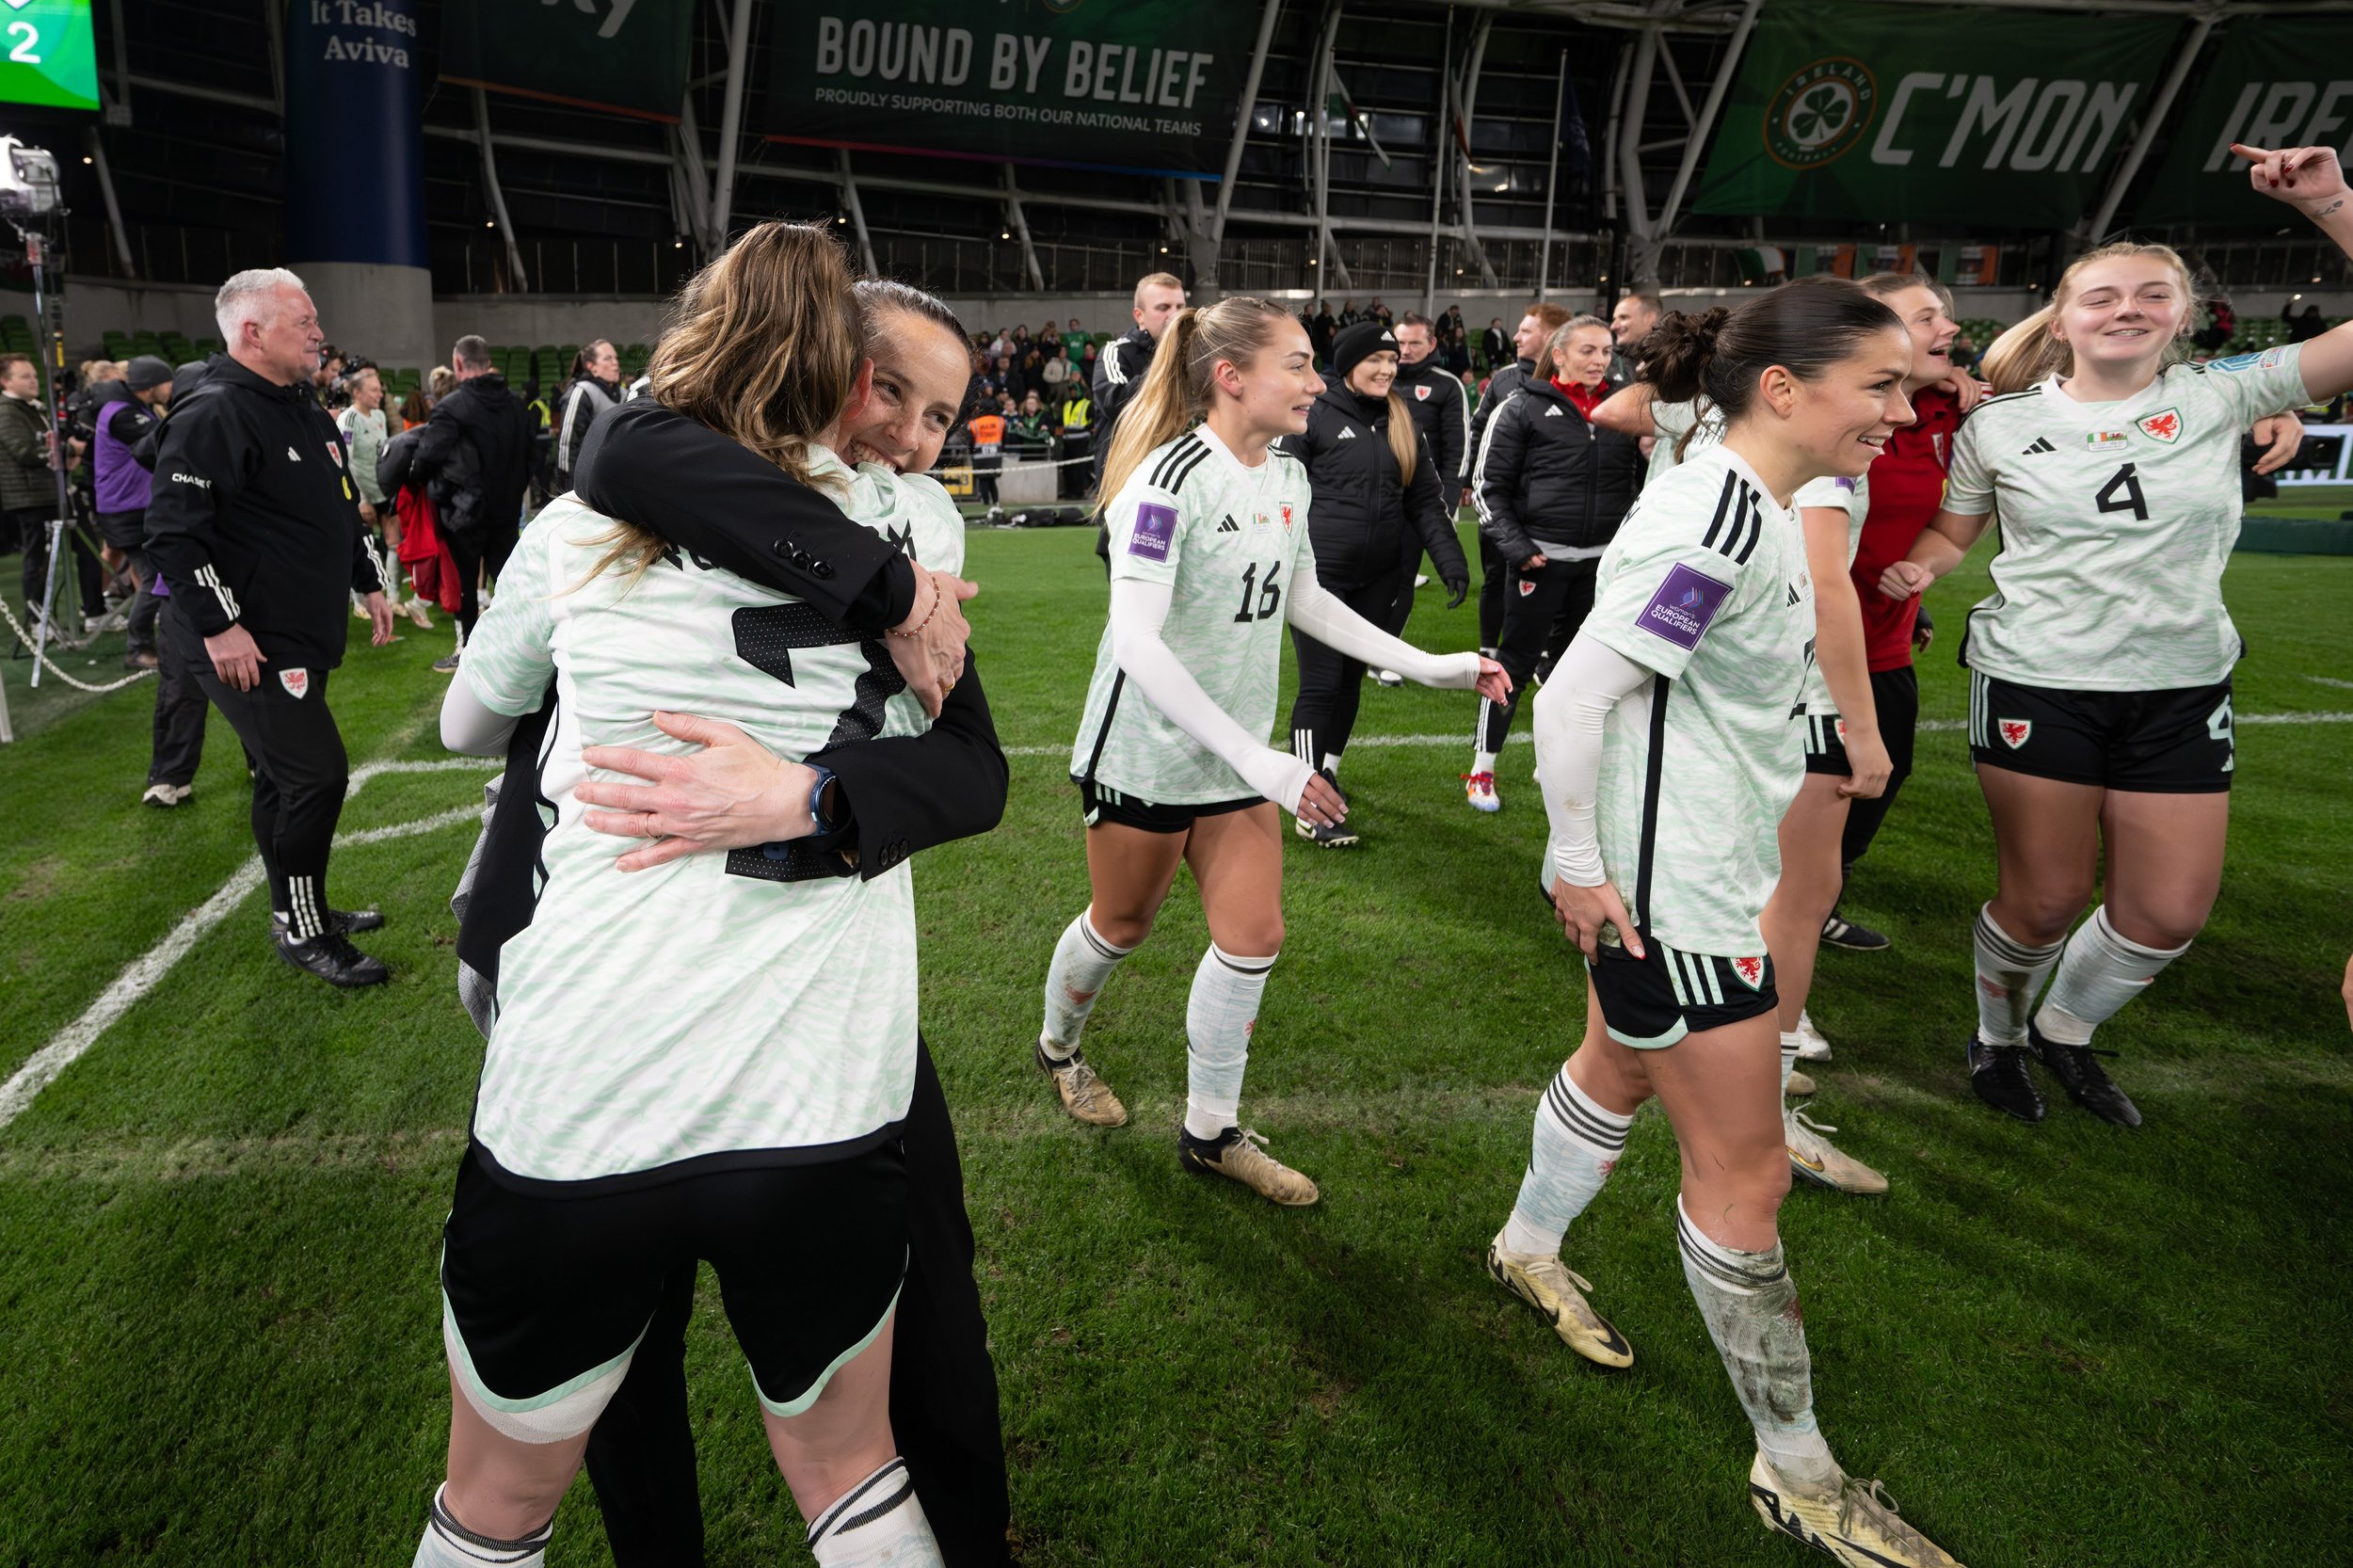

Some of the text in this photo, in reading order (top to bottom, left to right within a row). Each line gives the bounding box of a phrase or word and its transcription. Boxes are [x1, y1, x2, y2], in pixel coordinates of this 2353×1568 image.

[310, 0, 416, 38] It Takes
[8, 21, 42, 64] 2
[324, 35, 409, 69] Aviva
[816, 16, 1214, 109] BOUND BY BELIEF
[815, 87, 1203, 137] PROUDLY SUPPORTING BOTH OUR NATIONAL TEAMS
[1870, 71, 2138, 174] C'MON
[2201, 80, 2353, 173] IRE
[2095, 461, 2150, 520] 4
[1131, 537, 1166, 552] QUALIFIERS
[1133, 533, 1166, 546] EUROPEAN
[1233, 560, 1281, 623] 16
[1650, 610, 1698, 635] QUALIFIERS
[1655, 603, 1701, 629] EUROPEAN
[2206, 693, 2234, 749] 4
